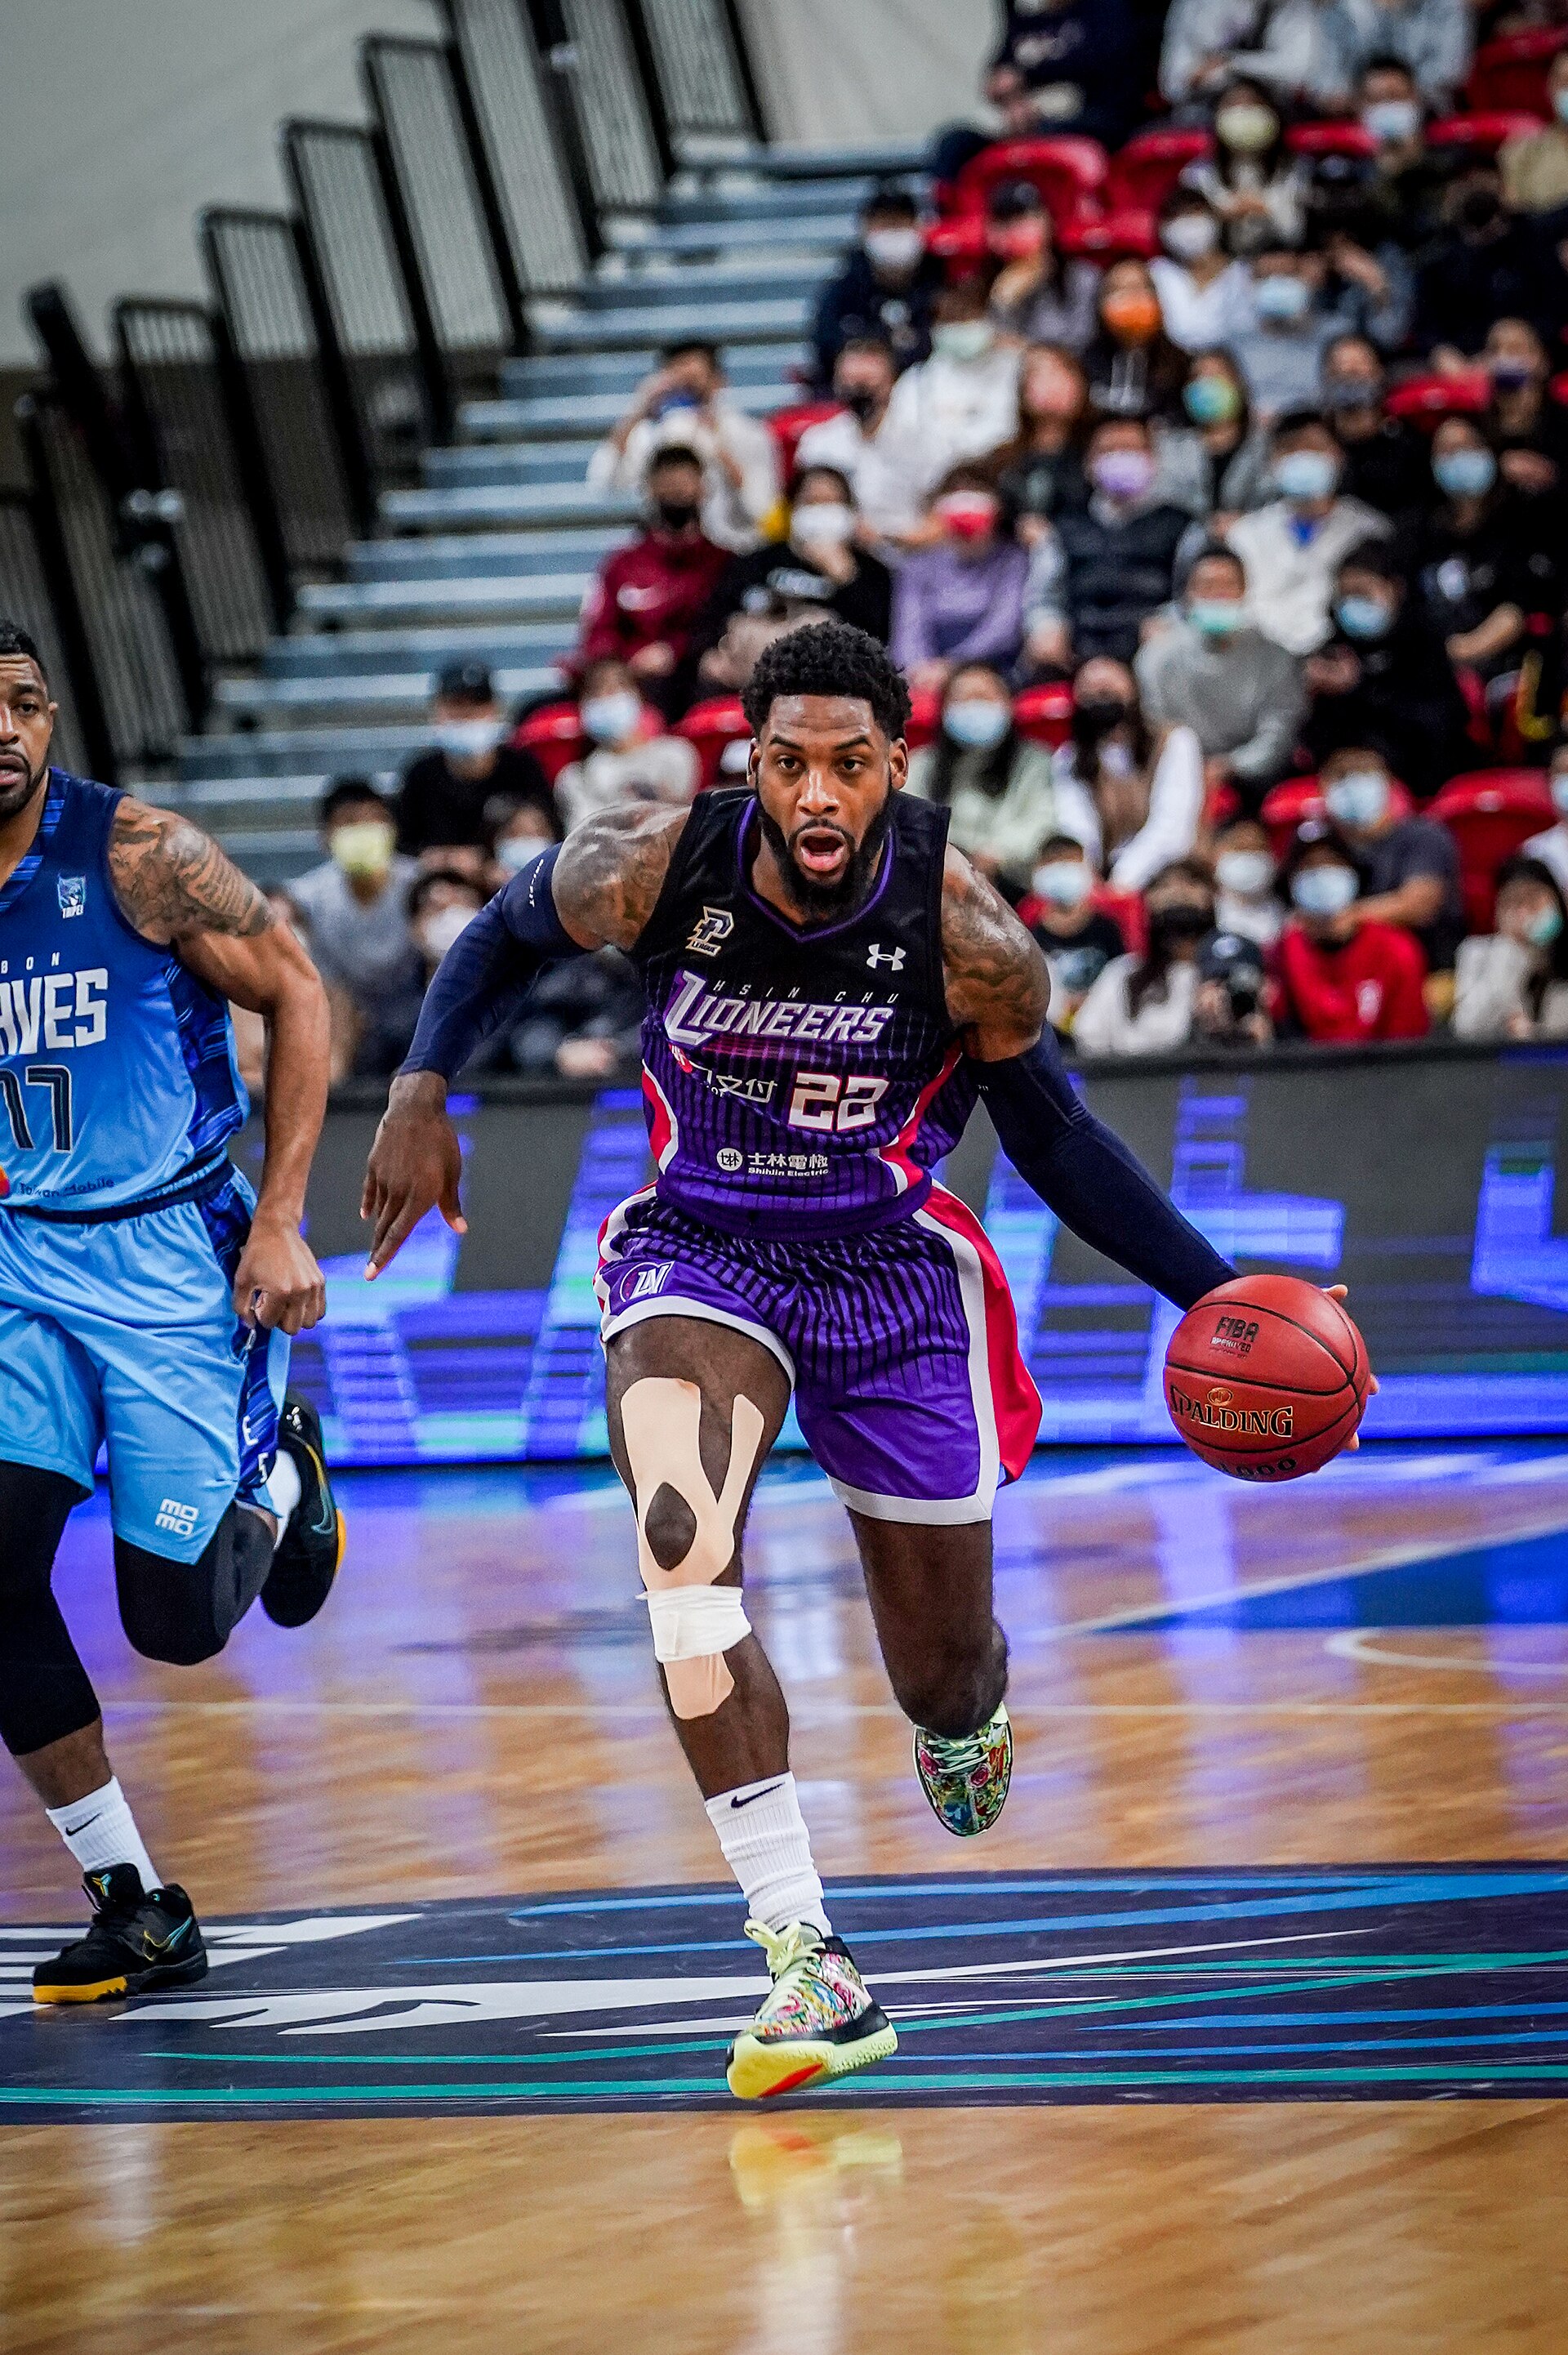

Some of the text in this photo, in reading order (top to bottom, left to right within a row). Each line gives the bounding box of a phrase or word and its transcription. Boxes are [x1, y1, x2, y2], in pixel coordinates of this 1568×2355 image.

[665, 970, 894, 1046] LIONEERS
[788, 1070, 889, 1131] 22
[748, 1166, 785, 1176] Shihlin
[1215, 1316, 1259, 1342] FIBA
